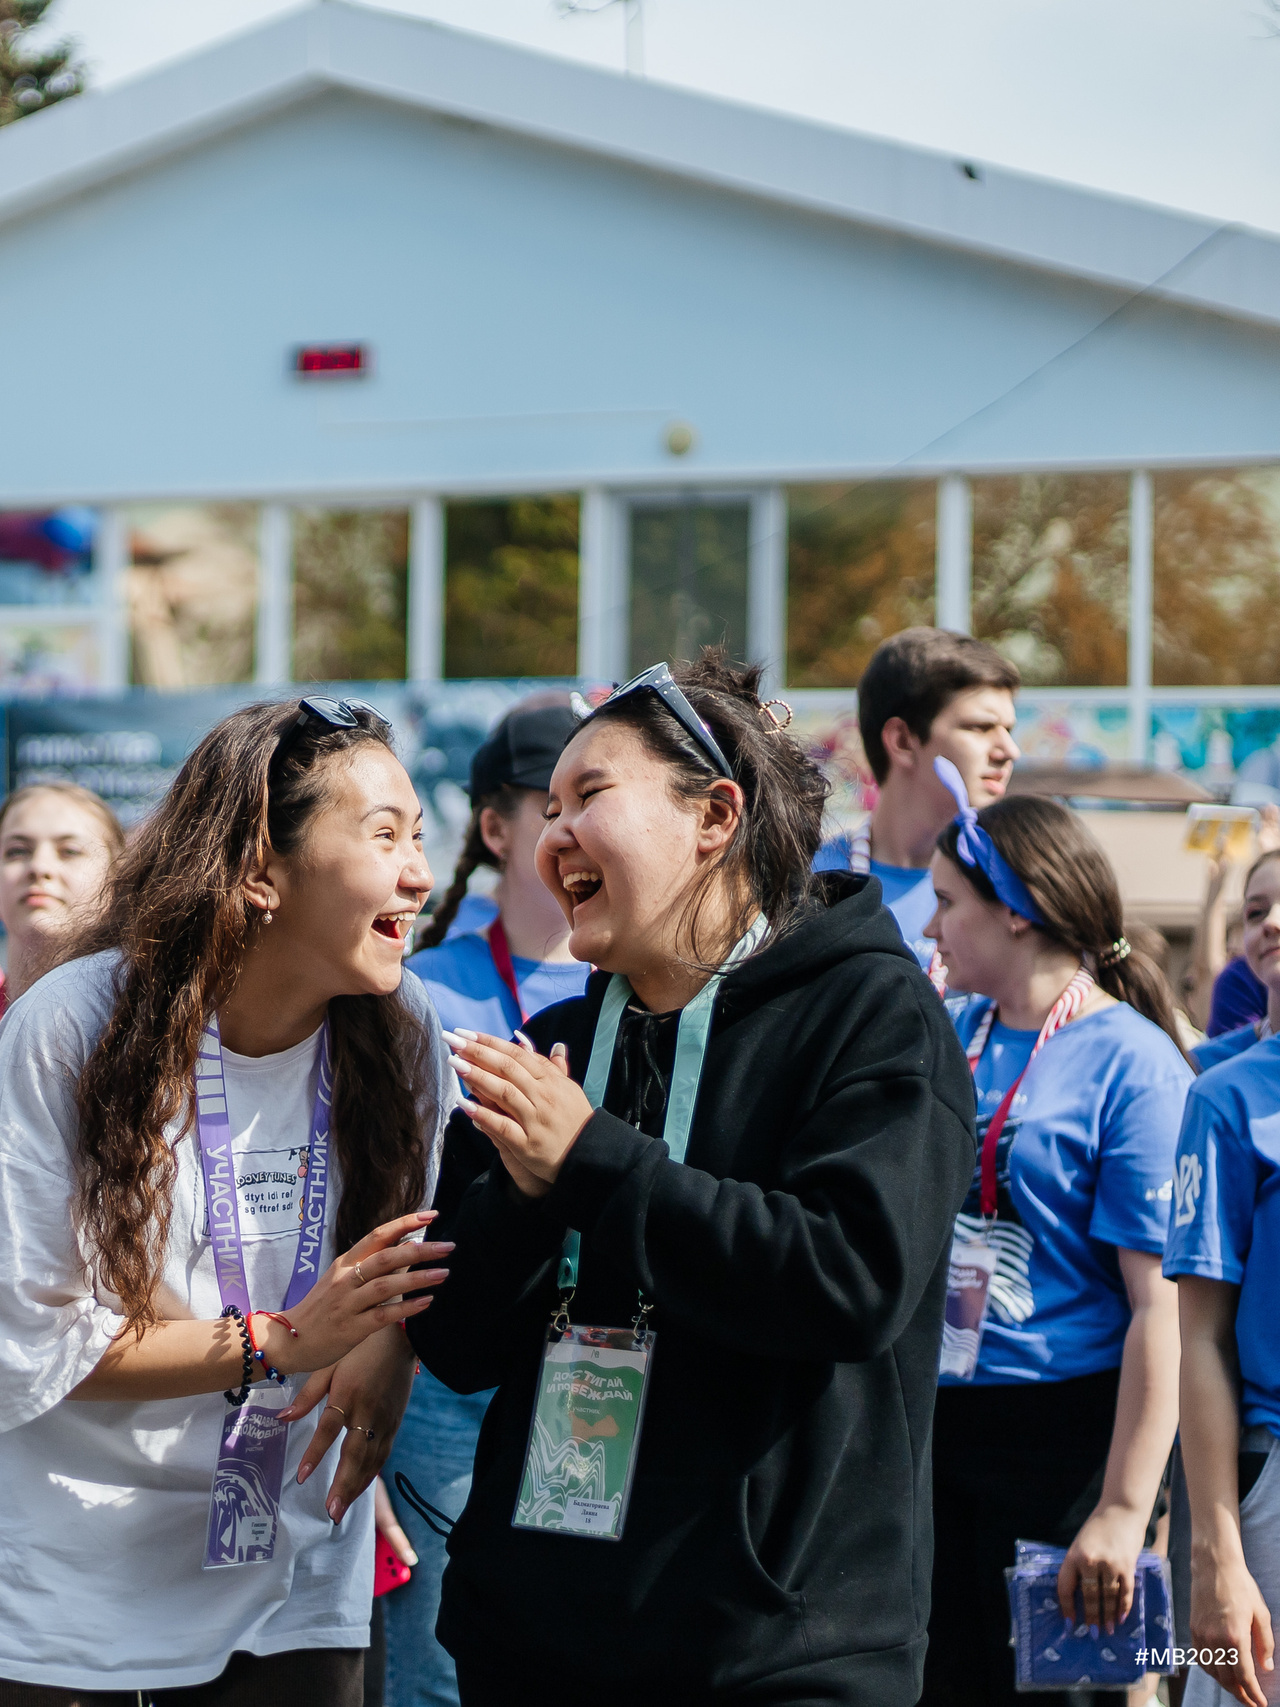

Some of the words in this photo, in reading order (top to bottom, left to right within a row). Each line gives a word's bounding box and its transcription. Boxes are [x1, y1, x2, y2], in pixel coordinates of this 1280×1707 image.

[244, 1192, 264, 1203] dtyt
[298, 1129, 329, 1274] УЧАСТНИК
[207, 1143, 244, 1291] УЧАСТНИК
[552, 1369, 624, 1389] ДОСТИГАЙ
[557, 1381, 633, 1401] ПОБЕЖДАЙ
